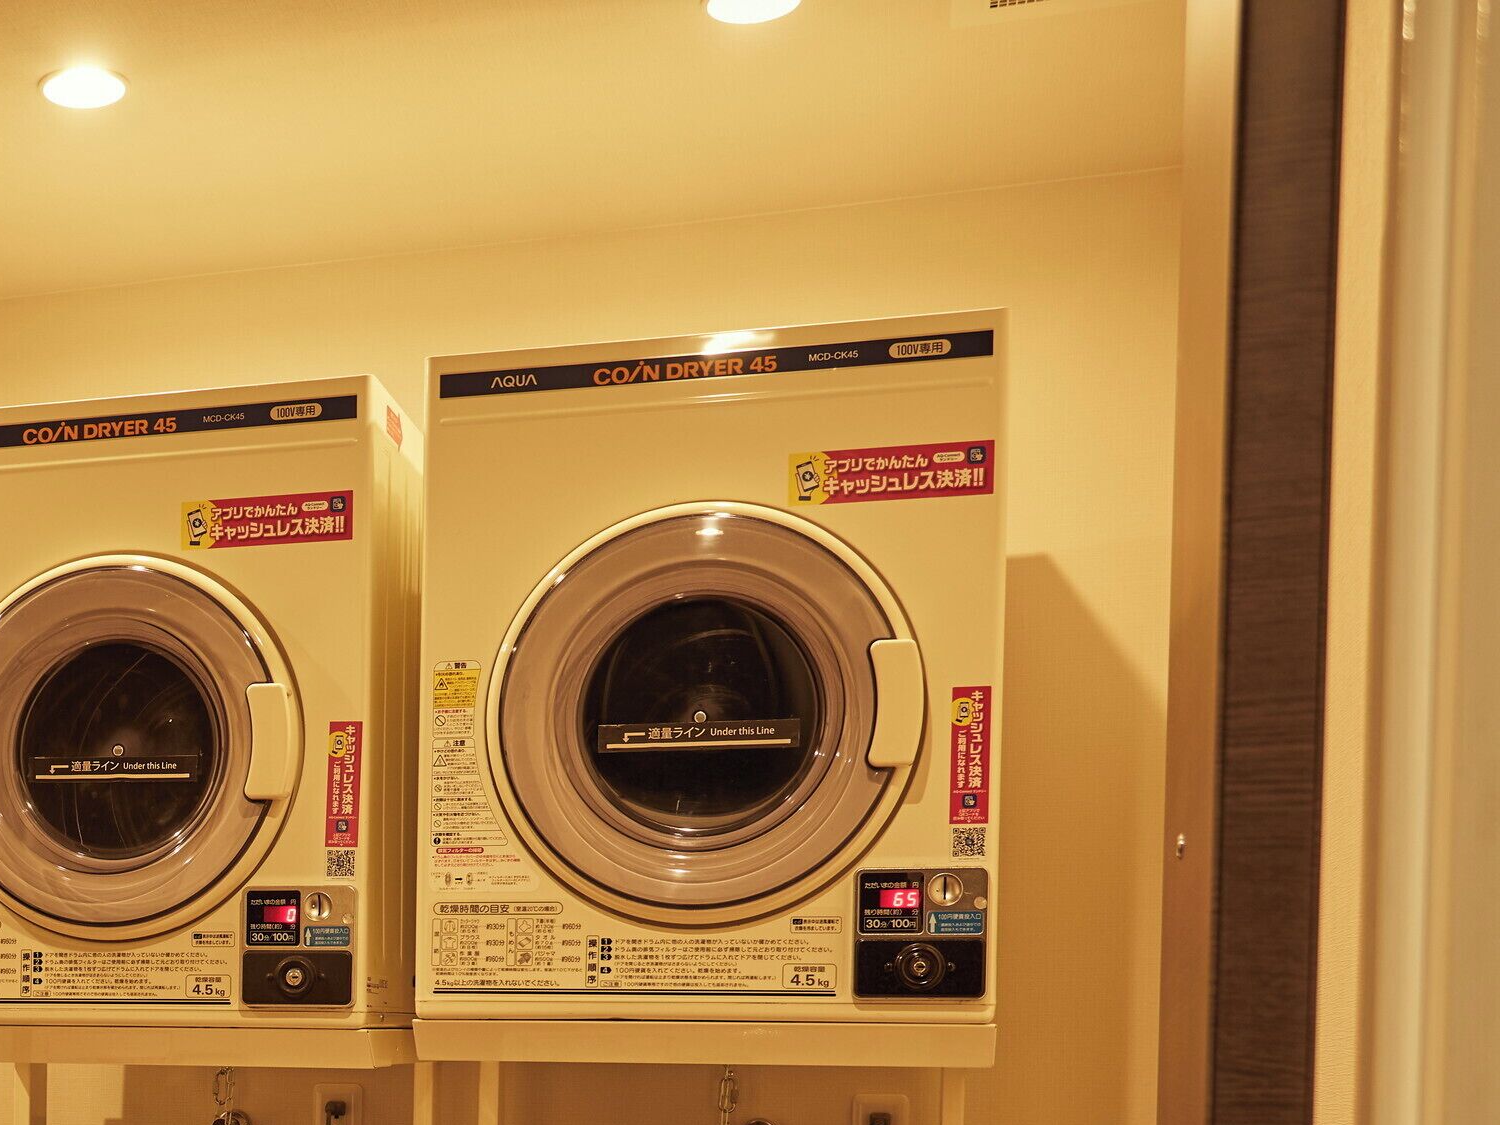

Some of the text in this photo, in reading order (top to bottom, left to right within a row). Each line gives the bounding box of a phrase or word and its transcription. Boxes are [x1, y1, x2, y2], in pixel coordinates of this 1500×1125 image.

[808, 350, 859, 362] MCD-CK45
[896, 341, 943, 356] 100V専用
[666, 358, 744, 380] DRYER
[749, 355, 778, 372] 45
[490, 373, 538, 389] AQUA
[202, 412, 245, 423] MCD-CK45
[276, 405, 316, 418] 100V専用
[83, 418, 148, 439] DRYER
[153, 417, 177, 433] 45
[823, 453, 929, 474] アプリでかんたん
[210, 502, 298, 521] アプリでかんたん
[648, 726, 775, 740] 適量ライン Under this Line
[968, 689, 984, 789] キャッシュレス決済
[71, 760, 177, 772] 適量ライン Under this Line
[341, 725, 357, 815] キャッシュレス決済
[892, 892, 918, 907] 65
[439, 904, 510, 914] 乾燥時間の目安
[865, 918, 917, 929] 30分/100円
[587, 938, 598, 985] 操作順序
